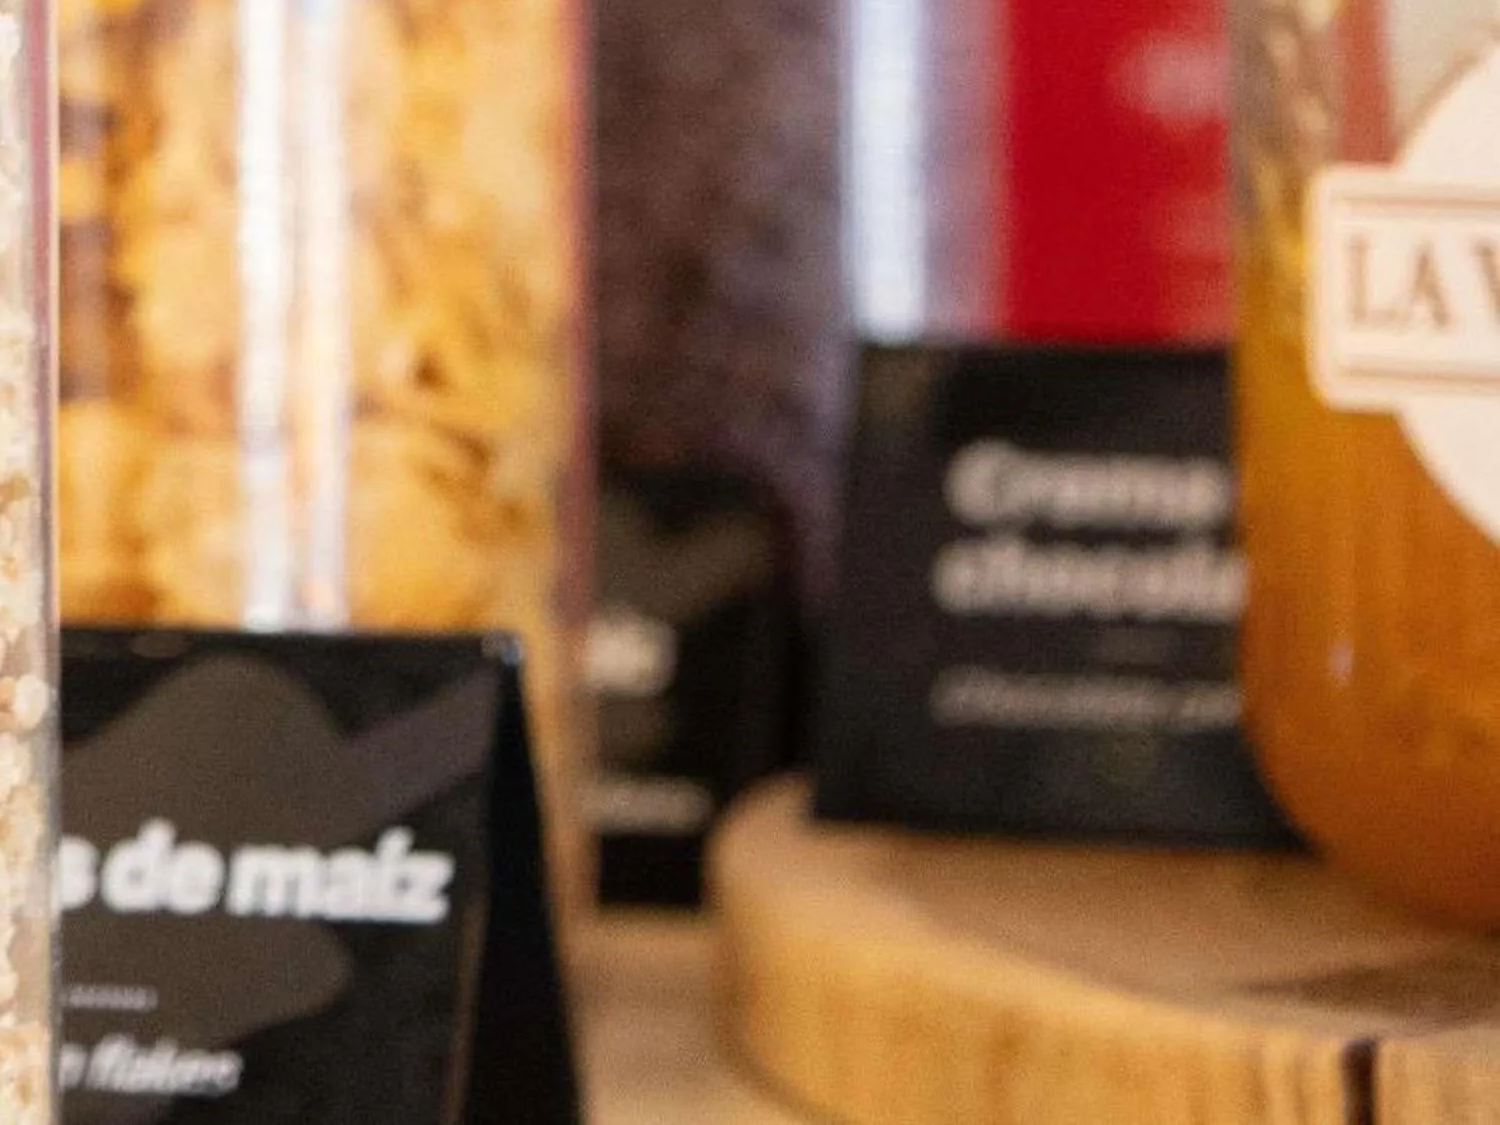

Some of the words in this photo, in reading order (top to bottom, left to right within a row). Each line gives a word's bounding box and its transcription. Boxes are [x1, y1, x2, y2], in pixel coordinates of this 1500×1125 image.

[1349, 237, 1451, 329] LA
[102, 820, 225, 913] de
[227, 828, 454, 922] maíz
